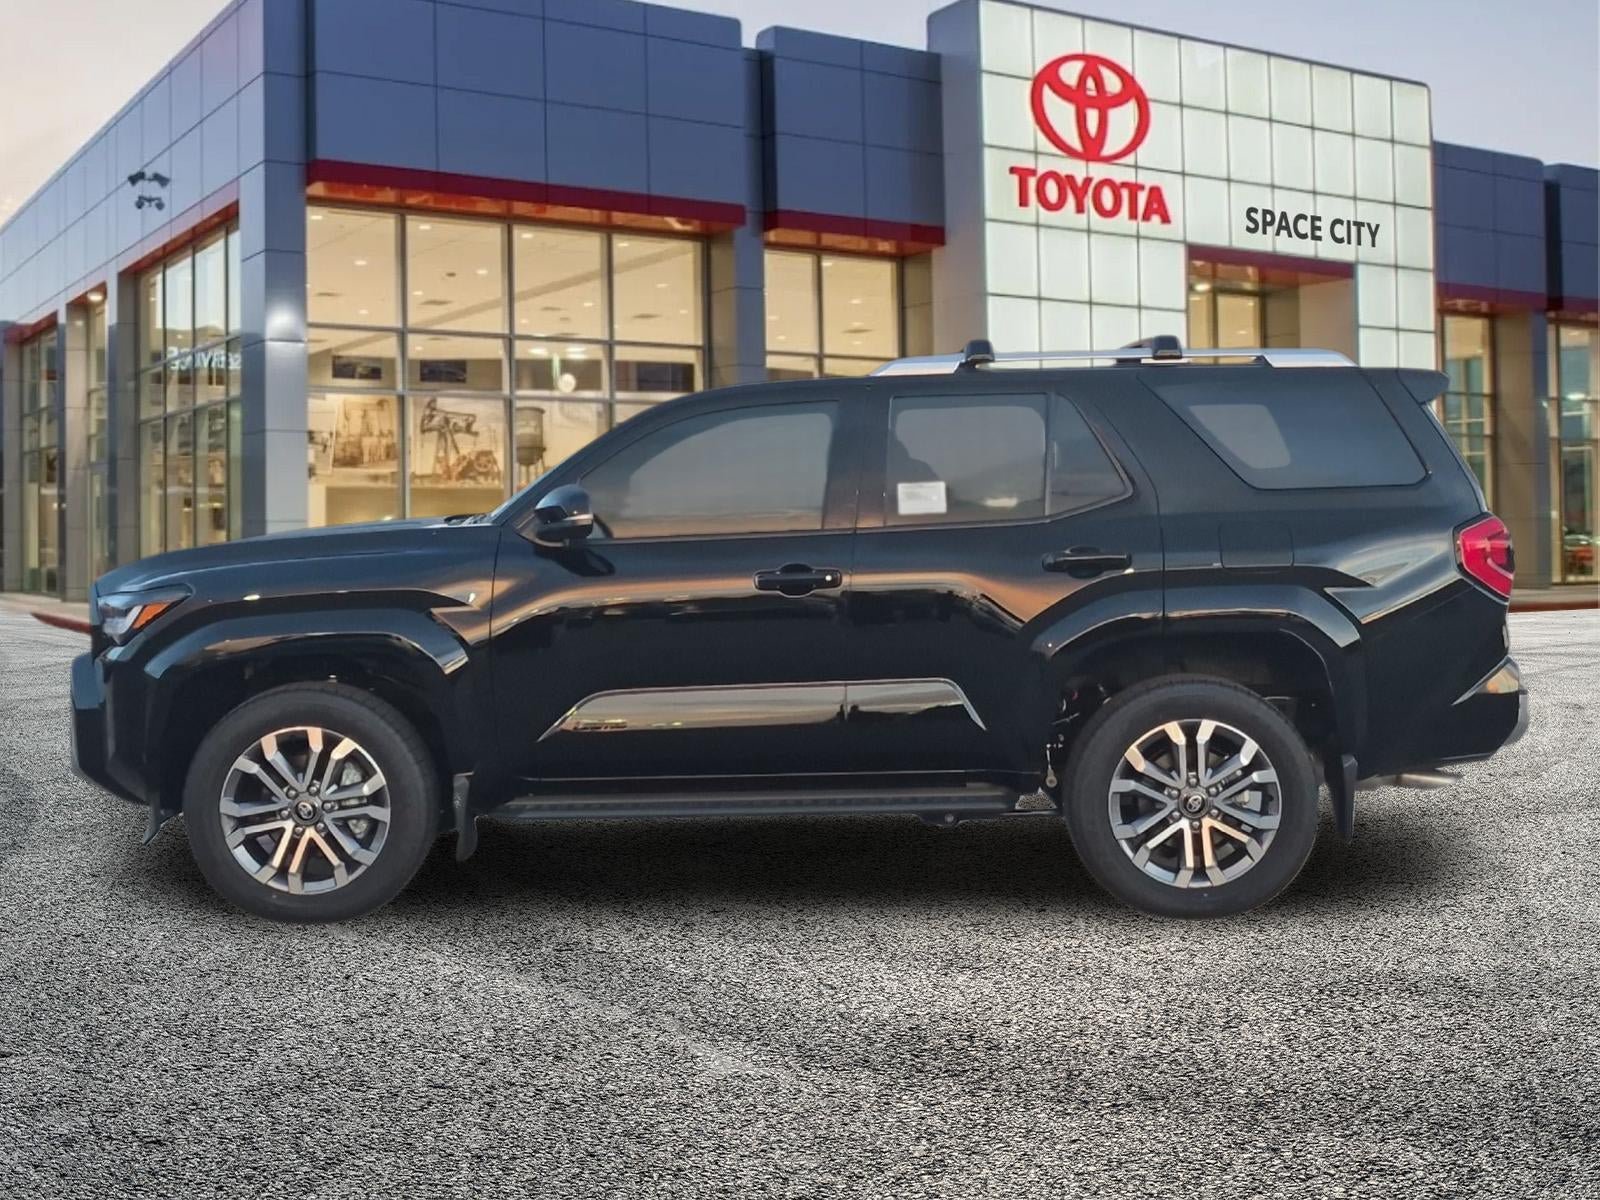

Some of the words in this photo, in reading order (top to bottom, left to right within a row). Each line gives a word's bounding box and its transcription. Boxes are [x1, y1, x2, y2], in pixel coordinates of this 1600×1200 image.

[1009, 165, 1171, 225] TOYOTA
[1245, 206, 1322, 242] SPACE
[1329, 217, 1381, 249] CITY
